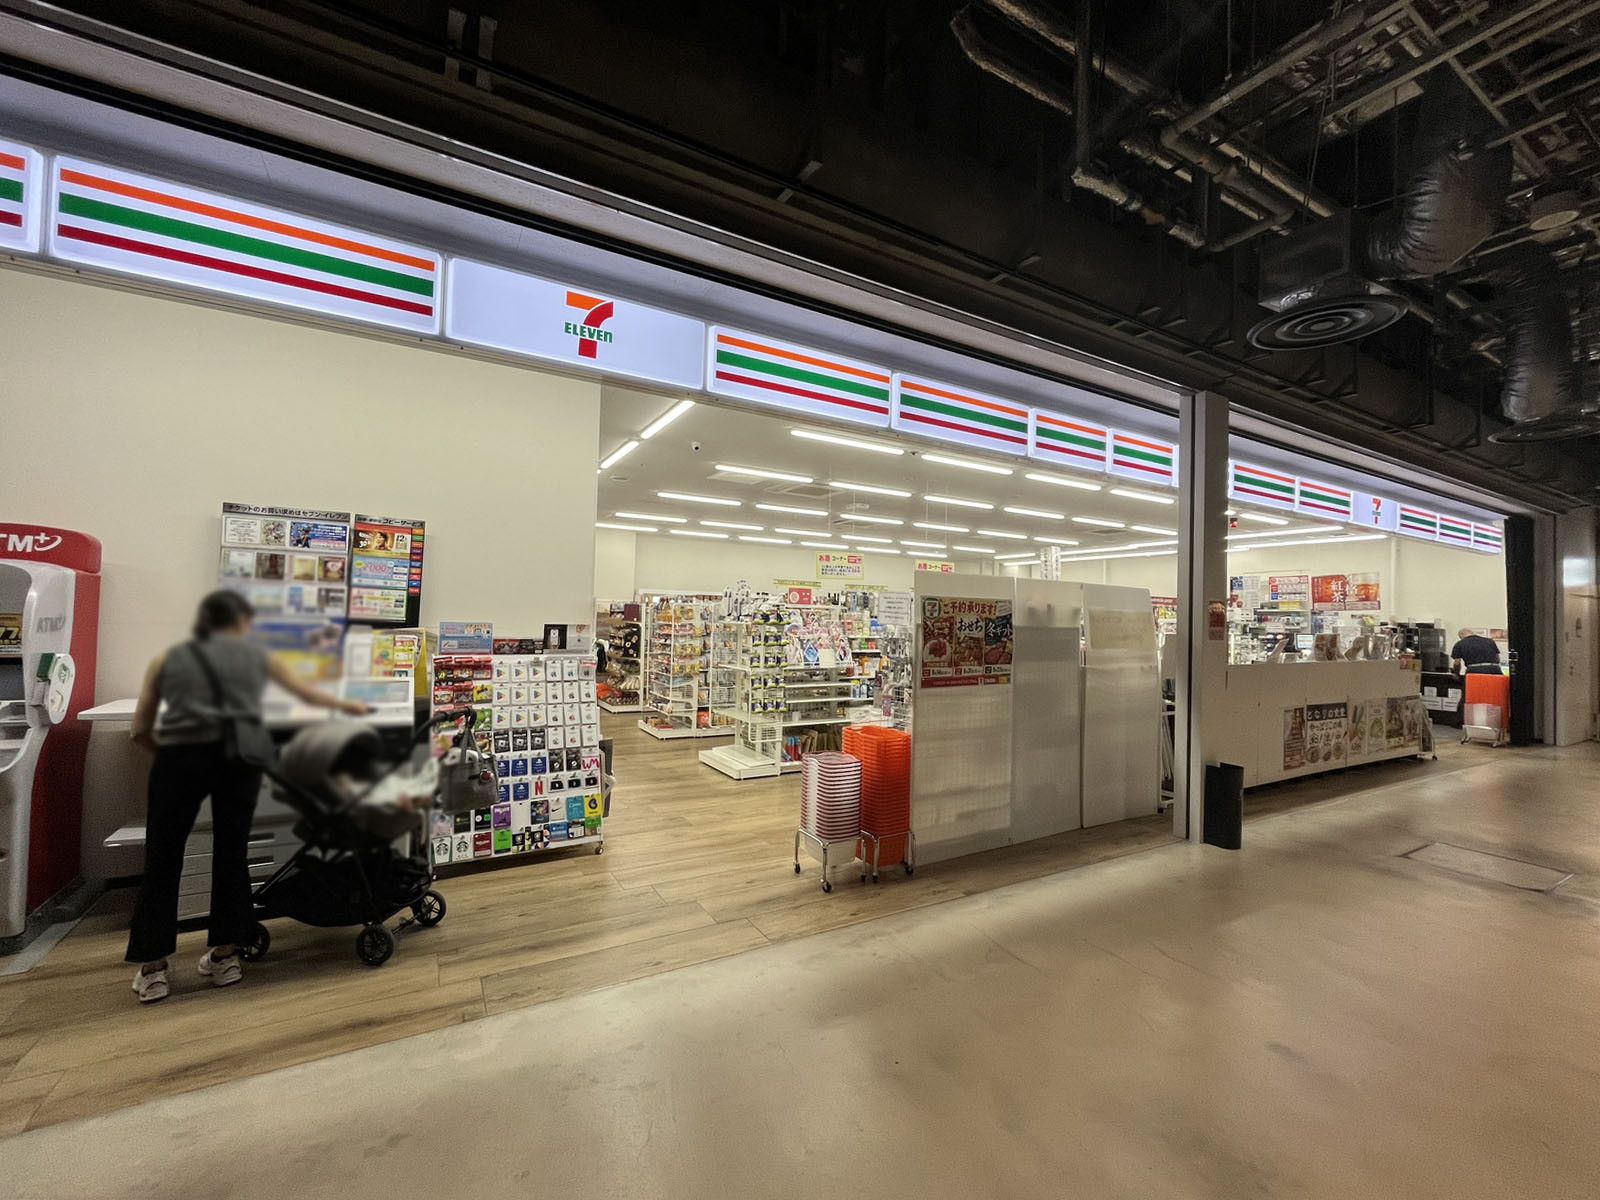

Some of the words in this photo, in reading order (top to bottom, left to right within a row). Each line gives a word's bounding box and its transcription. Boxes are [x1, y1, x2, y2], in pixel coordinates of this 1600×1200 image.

[566, 290, 614, 359] 7
[957, 617, 983, 633] おせち
